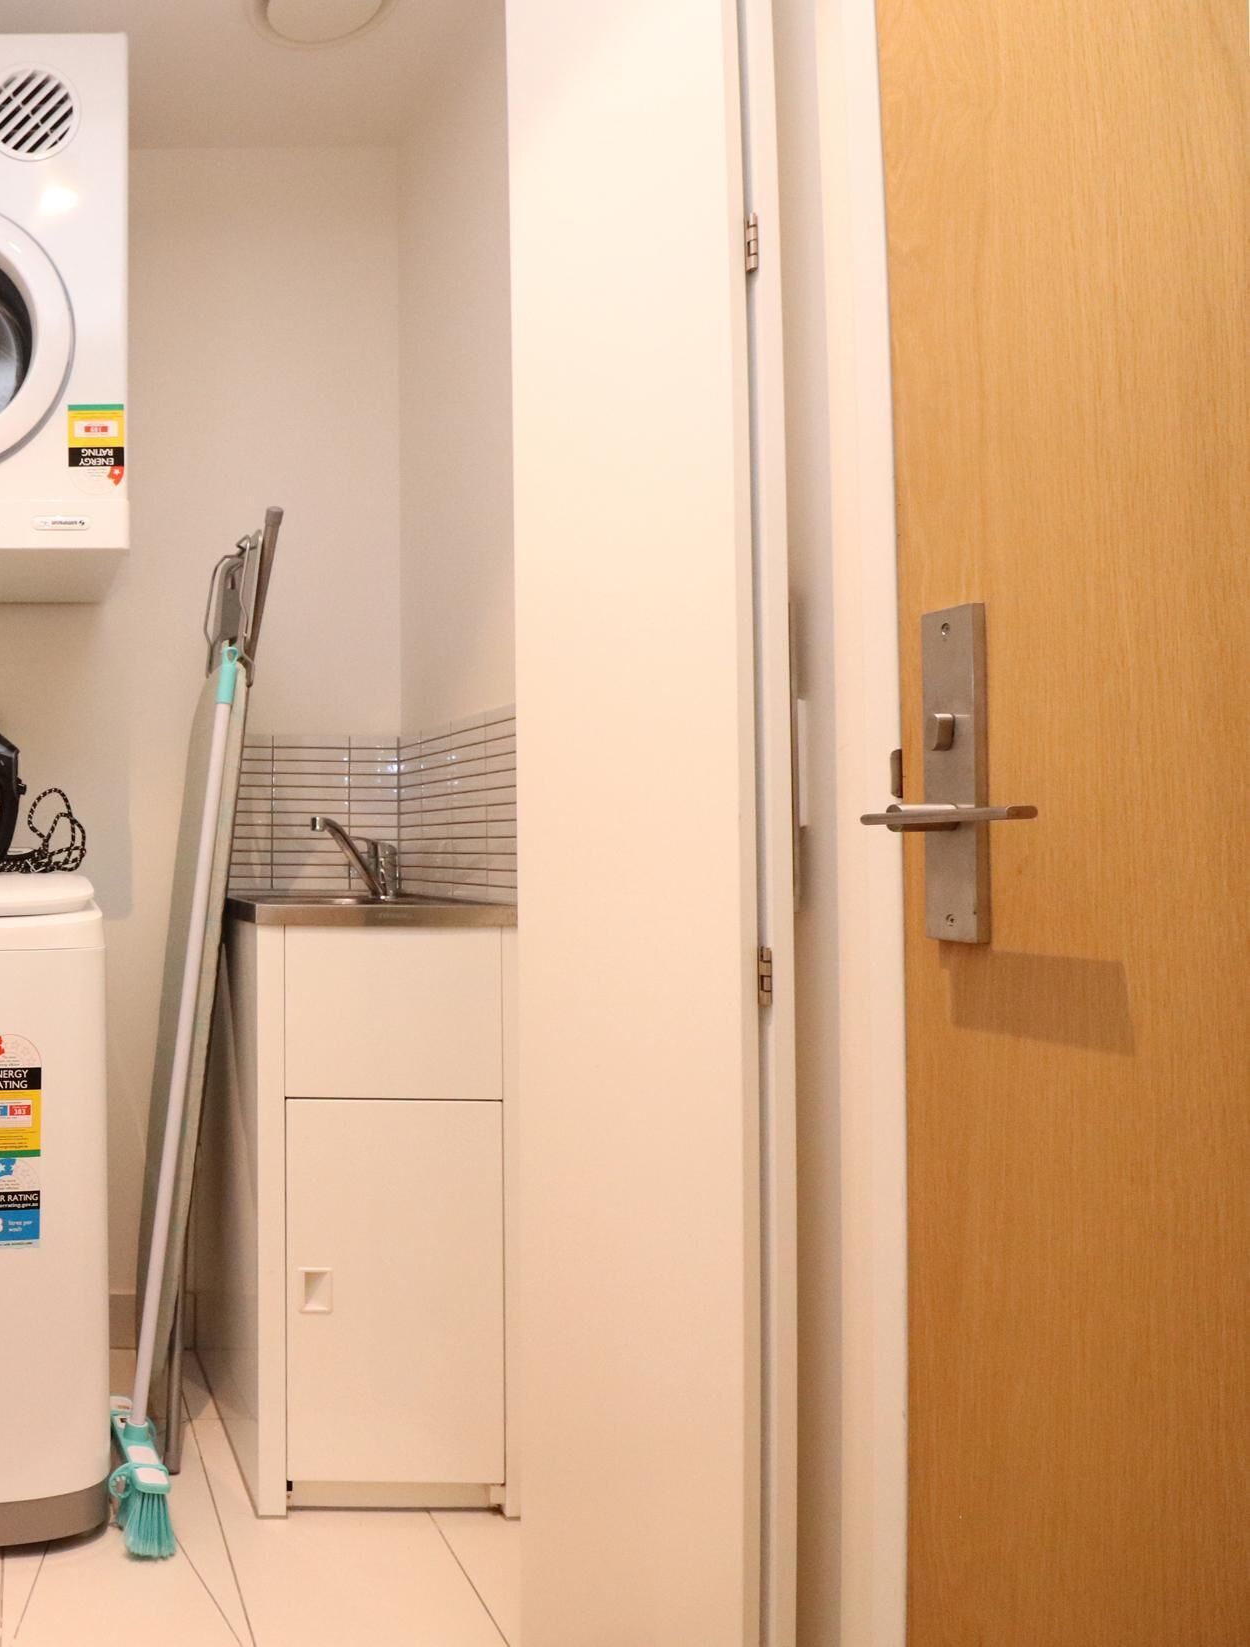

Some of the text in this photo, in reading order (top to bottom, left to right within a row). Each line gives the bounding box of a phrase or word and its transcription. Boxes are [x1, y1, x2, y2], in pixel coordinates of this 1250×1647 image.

[81, 448, 114, 457] RATING
[79, 457, 115, 466] ENERGY
[7, 1193, 39, 1202] RATING
